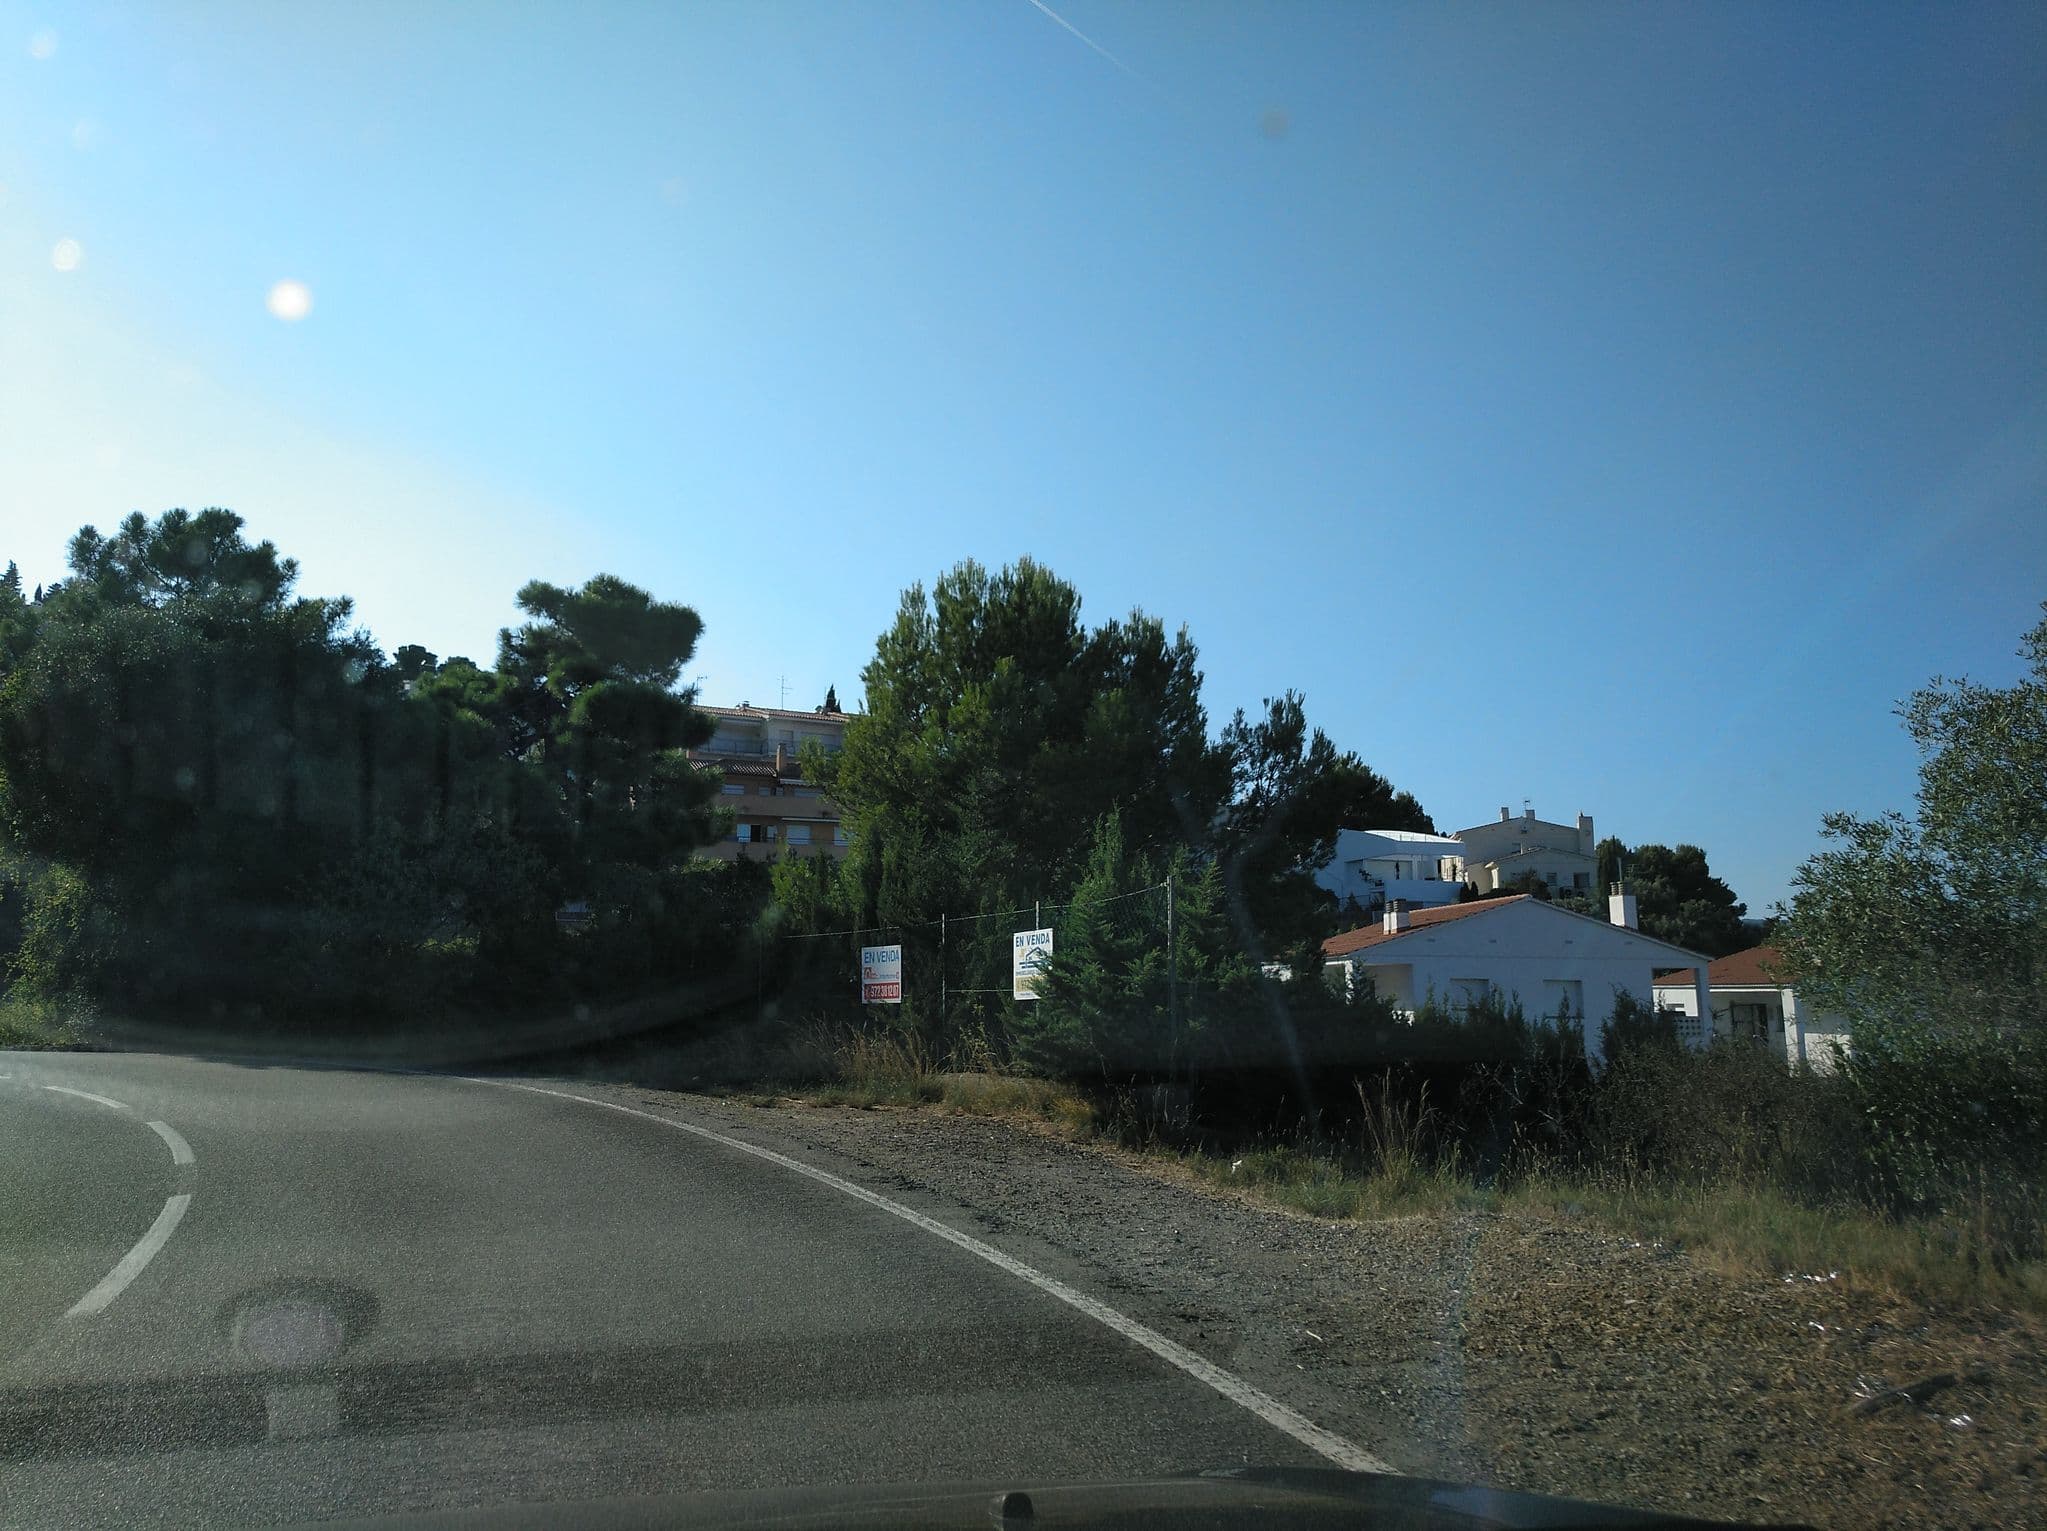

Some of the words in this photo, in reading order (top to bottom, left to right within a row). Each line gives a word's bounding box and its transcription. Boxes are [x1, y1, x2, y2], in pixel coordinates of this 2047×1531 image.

[1016, 936, 1024, 947] EN
[1026, 933, 1050, 946] VENDA
[864, 952, 874, 964] EN
[876, 950, 899, 962] VENDA
